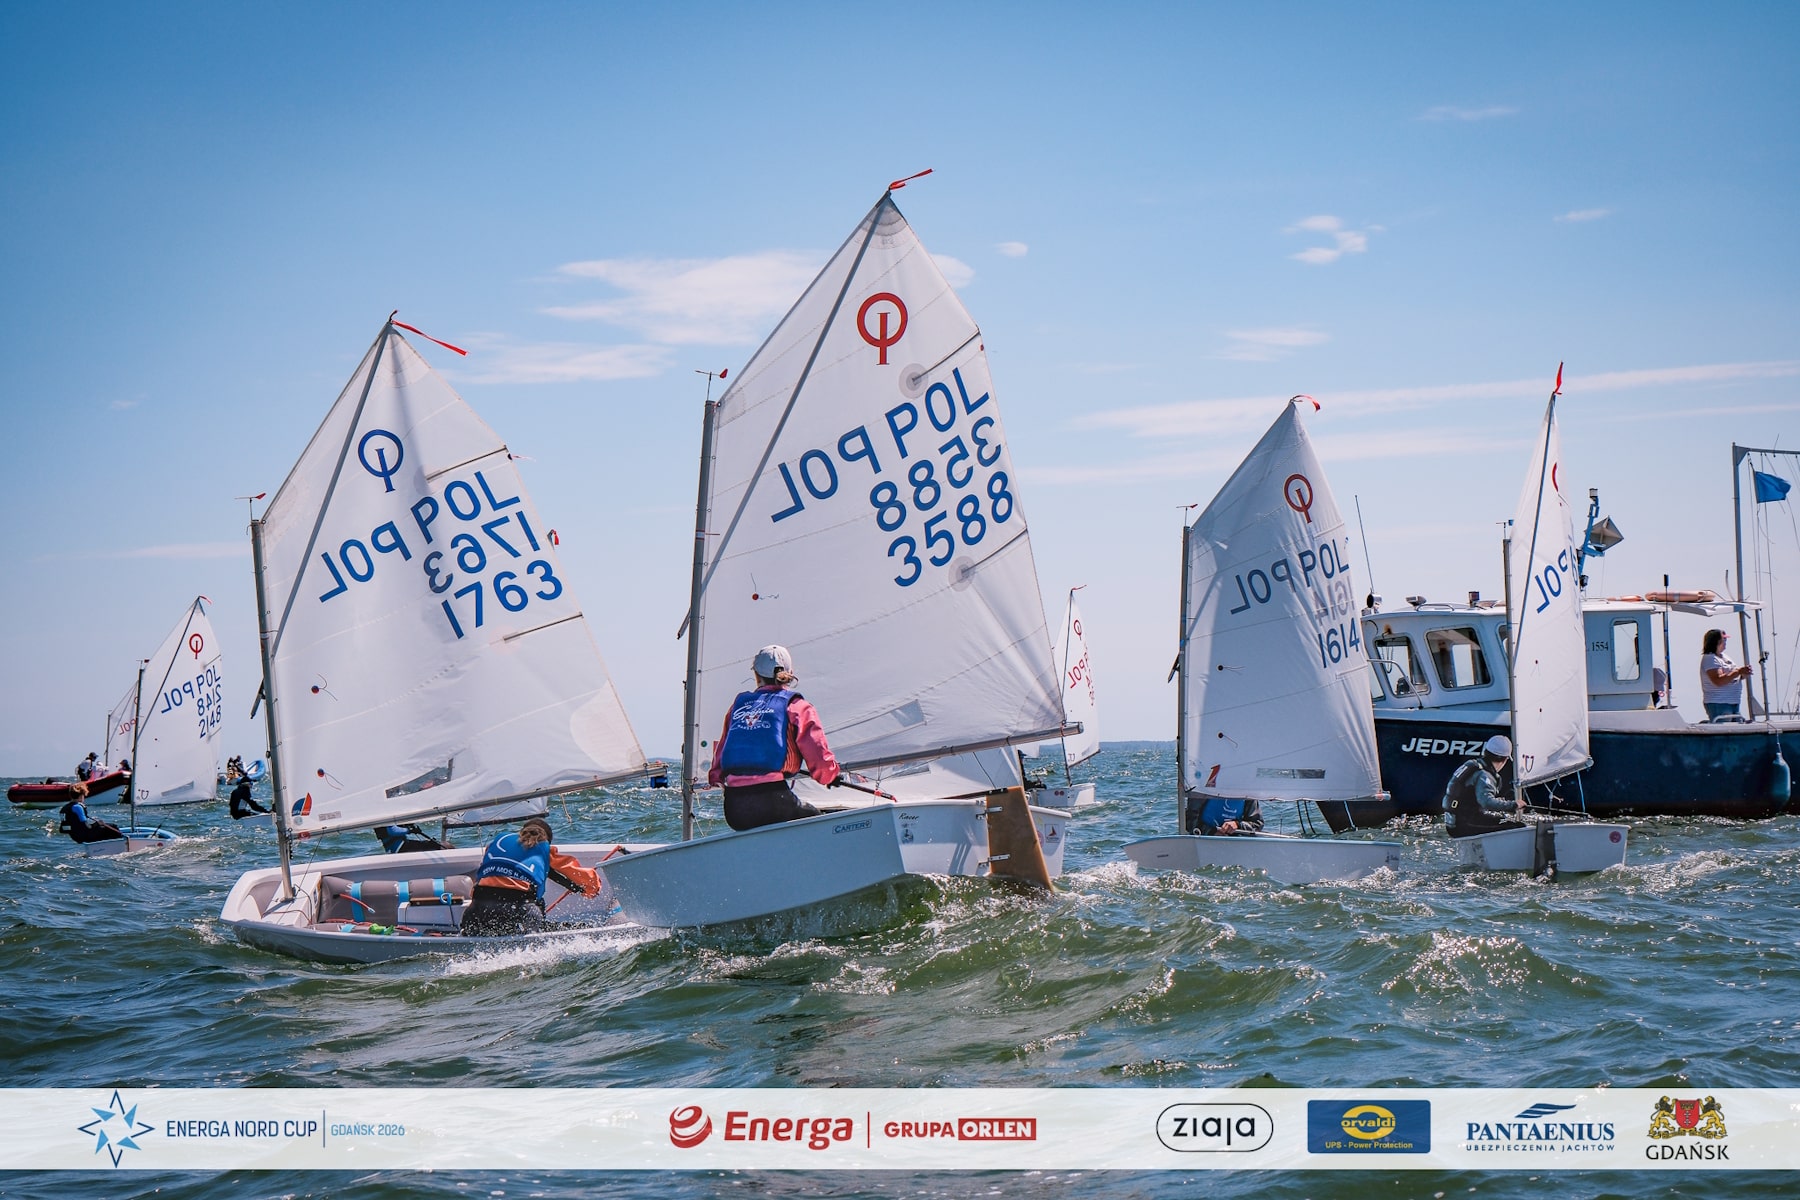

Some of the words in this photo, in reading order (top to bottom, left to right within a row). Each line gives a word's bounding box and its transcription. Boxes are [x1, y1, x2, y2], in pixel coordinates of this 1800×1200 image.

[885, 367, 990, 459] POL
[410, 471, 521, 545] POL
[887, 471, 1013, 587] 3588
[1299, 538, 1350, 588] POL
[441, 559, 563, 640] 1763
[1318, 618, 1361, 669] 1614
[1591, 641, 1609, 652] 1554
[196, 665, 222, 695] POL
[199, 705, 222, 739] 2148
[834, 820, 866, 834] CARTER
